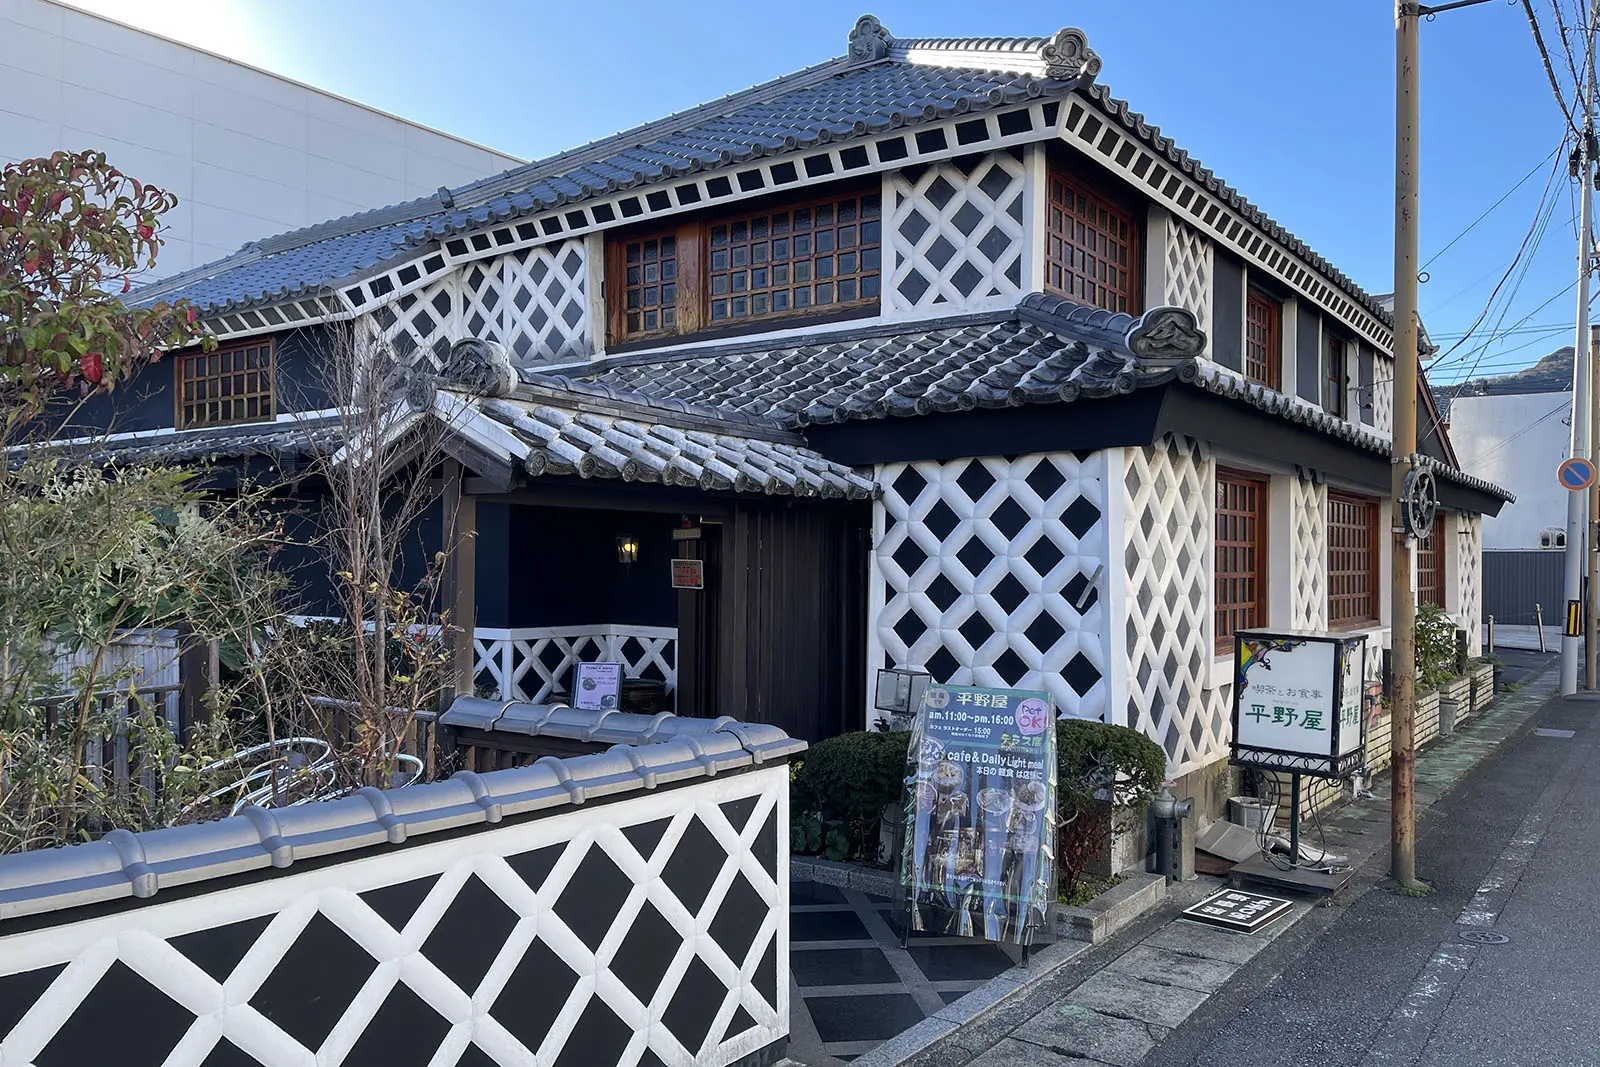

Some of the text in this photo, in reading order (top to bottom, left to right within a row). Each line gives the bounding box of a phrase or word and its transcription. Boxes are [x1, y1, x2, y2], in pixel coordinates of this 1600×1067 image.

[1252, 684, 1323, 699] 喫茶とお食事
[956, 692, 1008, 709] 平野屋
[1245, 703, 1327, 732] 平野屋
[974, 727, 991, 735] 15:00
[981, 753, 1006, 767] Daily
[1007, 755, 1027, 769] Light
[1027, 758, 1044, 769] meal
[976, 765, 997, 776] 本日の
